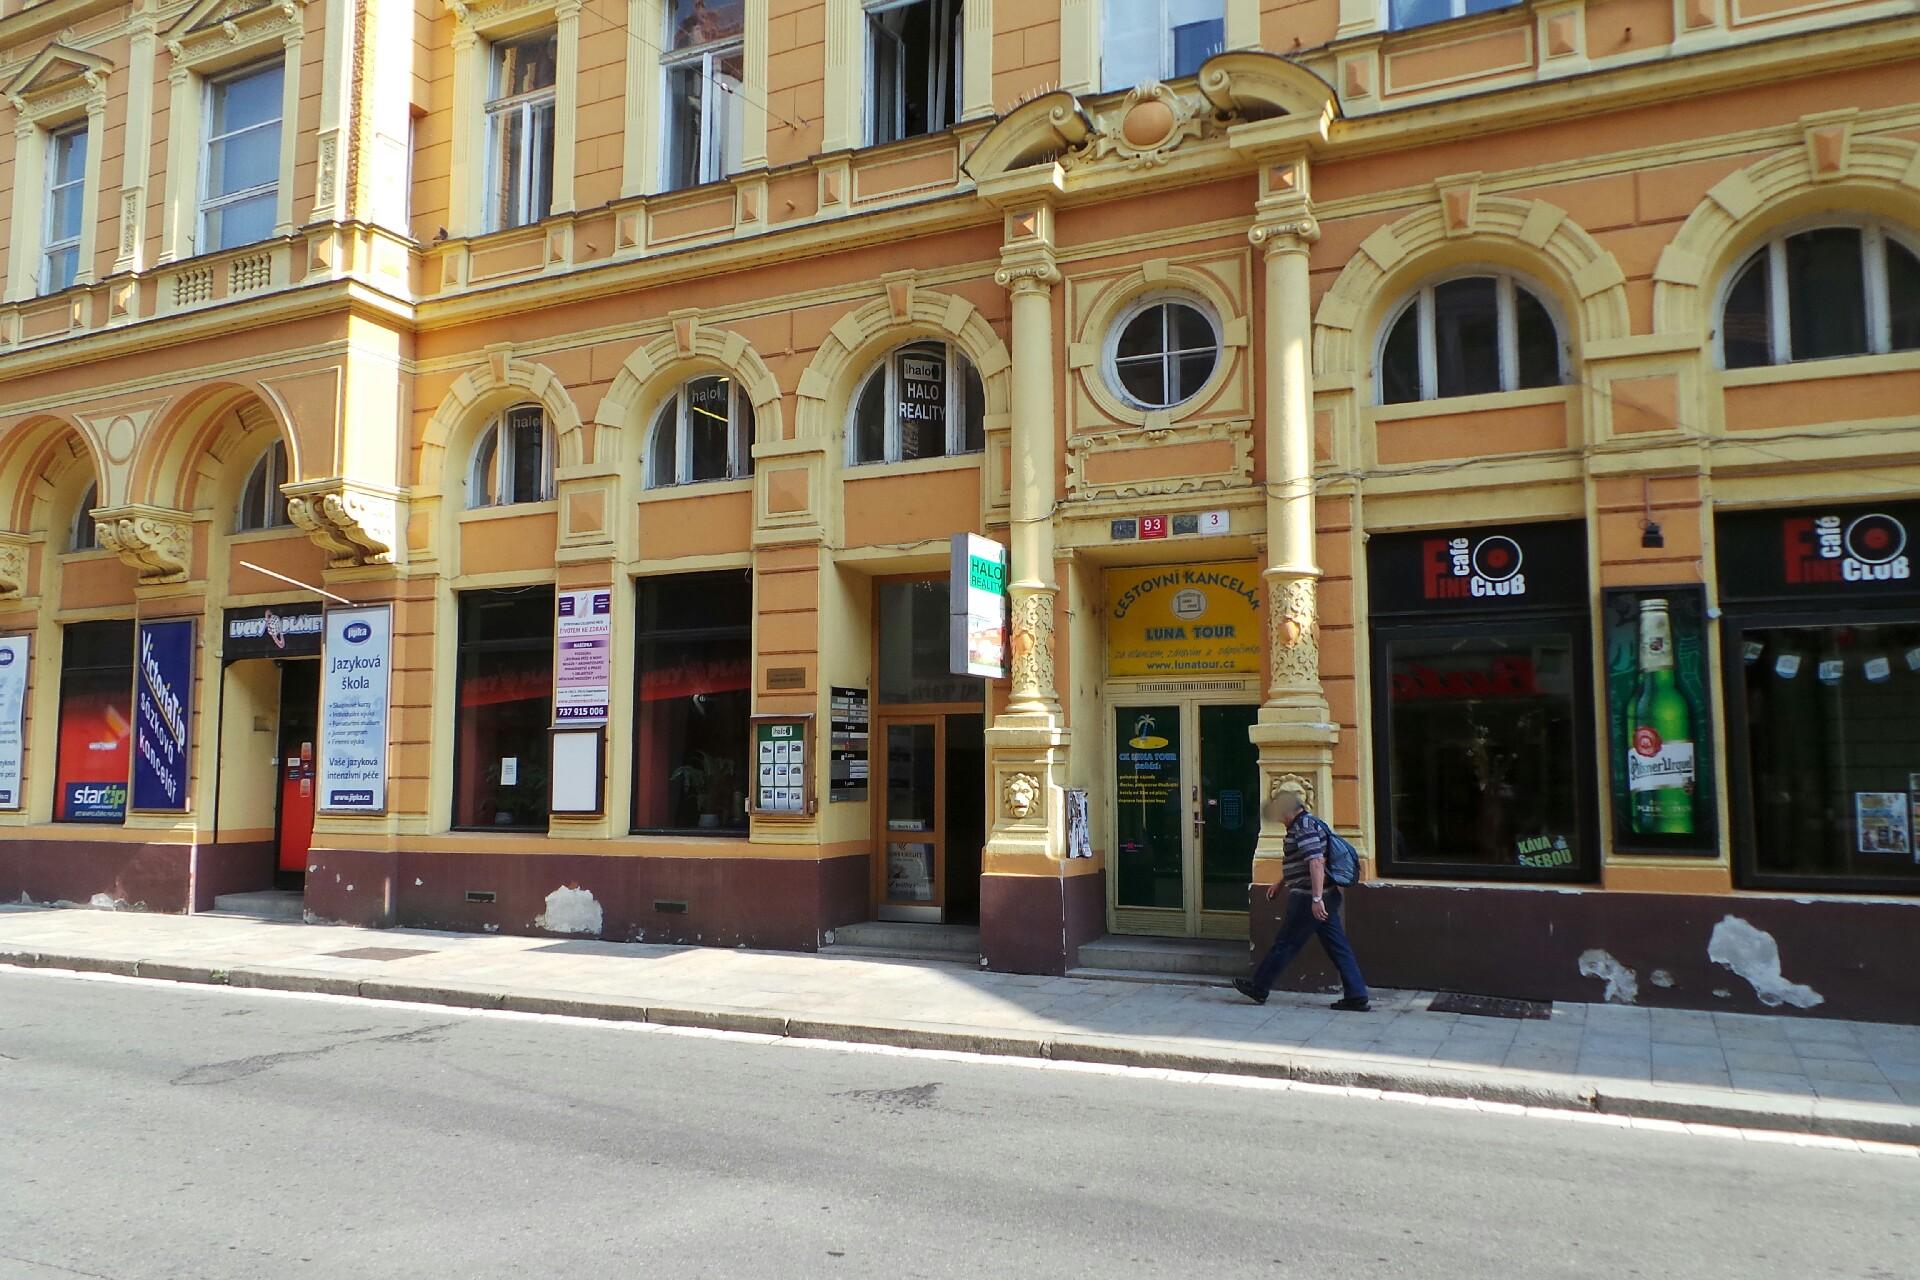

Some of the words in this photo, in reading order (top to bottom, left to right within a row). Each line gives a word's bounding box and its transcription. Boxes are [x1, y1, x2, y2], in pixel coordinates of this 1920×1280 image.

[907, 382, 939, 400] HALO
[900, 401, 946, 420] REALITY
[1144, 518, 1161, 531] 93
[1210, 514, 1219, 525] 3
[1815, 516, 1842, 558] café
[1449, 538, 1470, 576] café
[972, 558, 1003, 580] HALO
[1842, 555, 1910, 581] CLUB
[971, 575, 1003, 593] REALITY
[1470, 573, 1526, 597] CLUB
[1114, 570, 1181, 619] CESTOVNÍ
[229, 618, 267, 638] LUCKY
[1145, 627, 1187, 641] LUNA
[1192, 624, 1236, 640] TOUR
[331, 654, 381, 673] Jazyková
[1146, 659, 1236, 670] www.lunatour.cz
[142, 630, 185, 754] VictoriaTip
[341, 675, 370, 690] škola
[559, 707, 573, 716] 737
[573, 707, 588, 716] 915
[589, 707, 604, 715] 006
[329, 756, 346, 766] Vaše
[346, 756, 378, 768] jazyková
[1517, 836, 1552, 854] KÁVA
[1525, 848, 1573, 868] SEBOU
